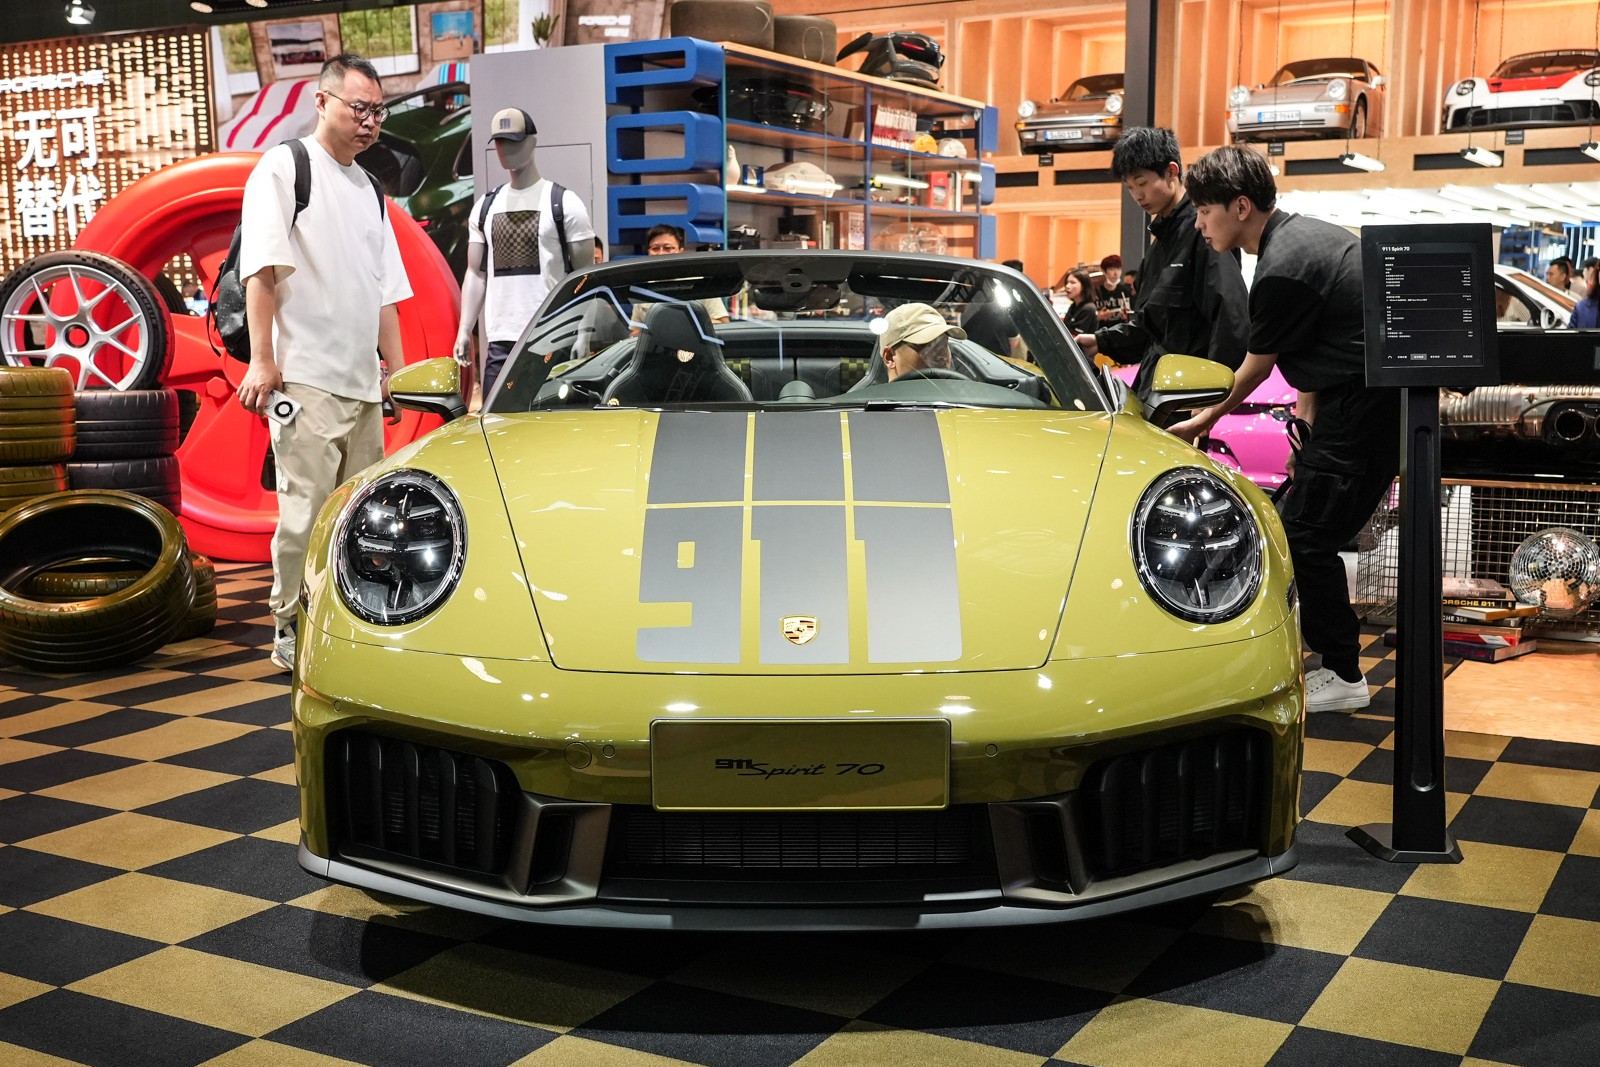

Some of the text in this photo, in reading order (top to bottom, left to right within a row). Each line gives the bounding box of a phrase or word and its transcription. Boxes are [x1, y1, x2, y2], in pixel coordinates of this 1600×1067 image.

[14, 106, 99, 171] 无可
[16, 173, 104, 237] 替代
[636, 505, 962, 664] 911
[738, 763, 826, 780] Spirit
[836, 763, 886, 776] 70
